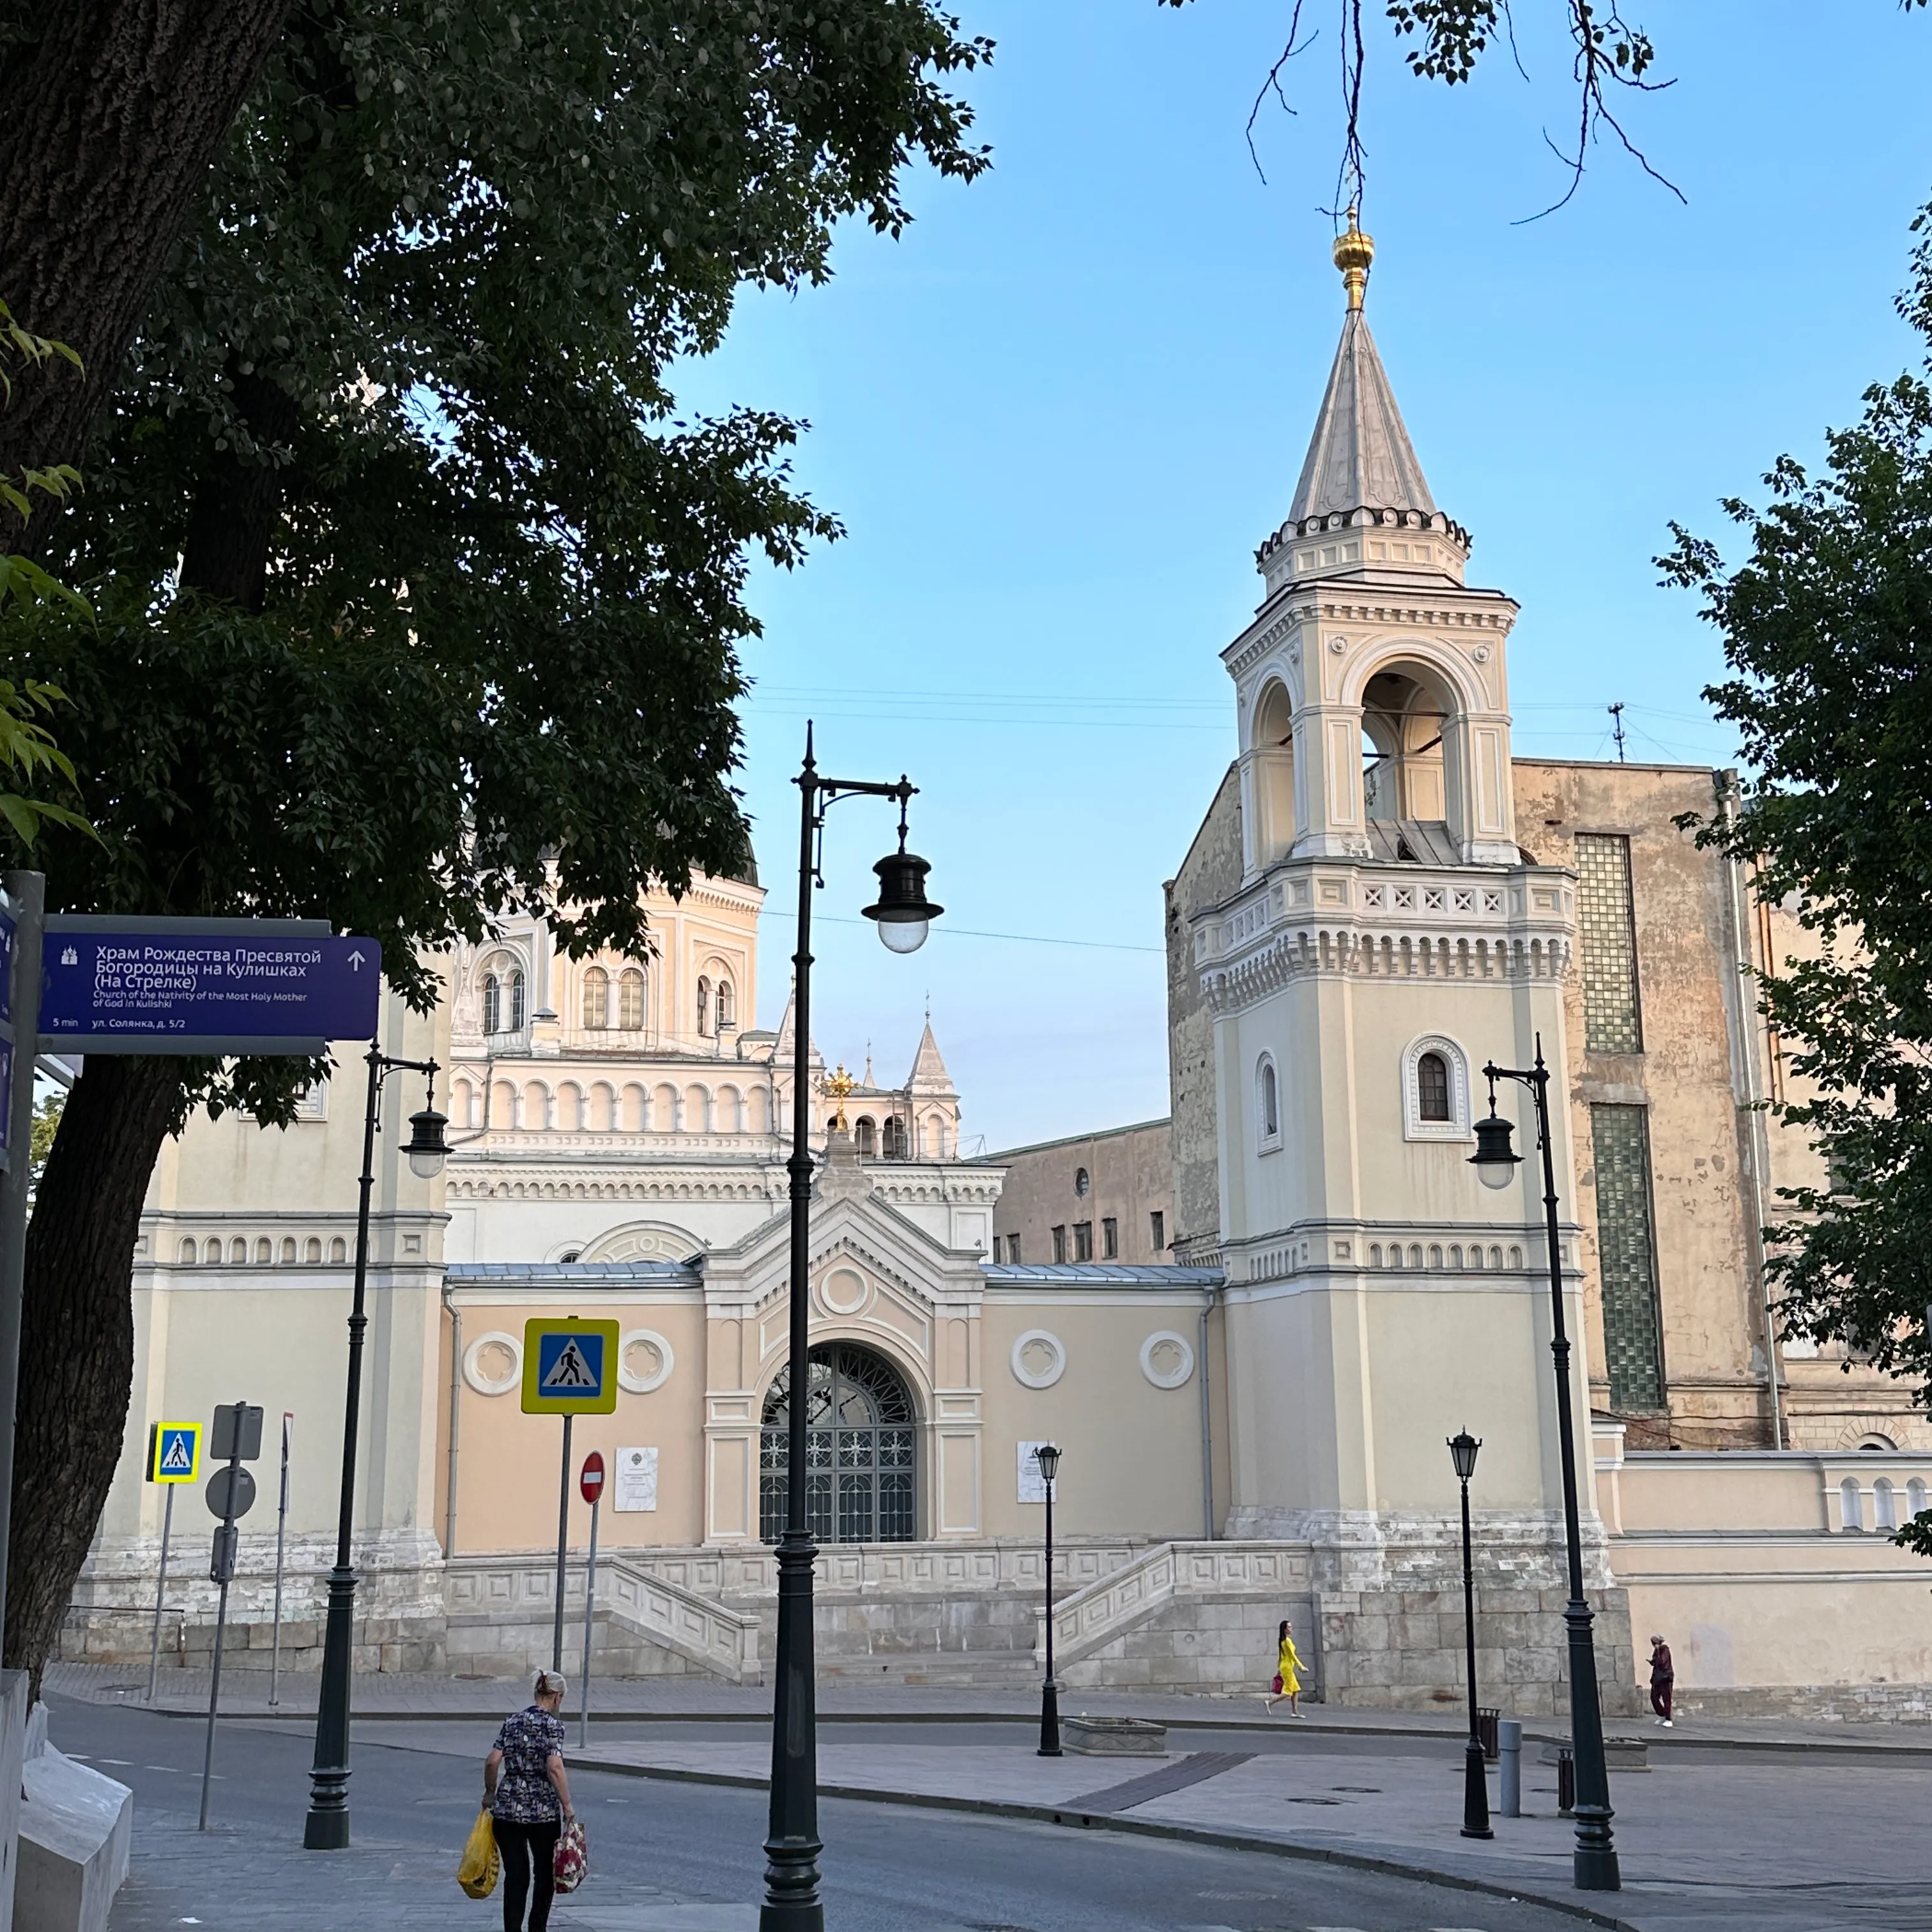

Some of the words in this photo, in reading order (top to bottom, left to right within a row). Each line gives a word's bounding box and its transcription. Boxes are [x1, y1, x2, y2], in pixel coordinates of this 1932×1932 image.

[96, 946, 139, 962] Храм
[144, 947, 231, 963] Рождества
[235, 949, 321, 965] Пресвятой
[96, 960, 198, 977] Богородицы
[203, 964, 222, 975] на
[227, 963, 306, 979] Кулишках
[95, 974, 121, 990] (На
[125, 975, 196, 992] Стрелке)
[93, 990, 126, 999] Church
[128, 990, 139, 999] of
[140, 991, 156, 999] the
[158, 992, 195, 1002] Nativity
[197, 992, 207, 1000] of
[208, 992, 224, 1000] the
[226, 992, 249, 1000] Most
[251, 992, 272, 1002] Holy
[273, 993, 307, 1001] Mother
[93, 999, 103, 1008] of
[136, 1000, 172, 1008] Kulishki
[53, 1018, 59, 1027] 5
[61, 1018, 78, 1027] min
[91, 1020, 107, 1029] ул.
[109, 1019, 155, 1029] Солянка,
[157, 1020, 166, 1029] д.
[169, 1020, 185, 1029] 5/2
